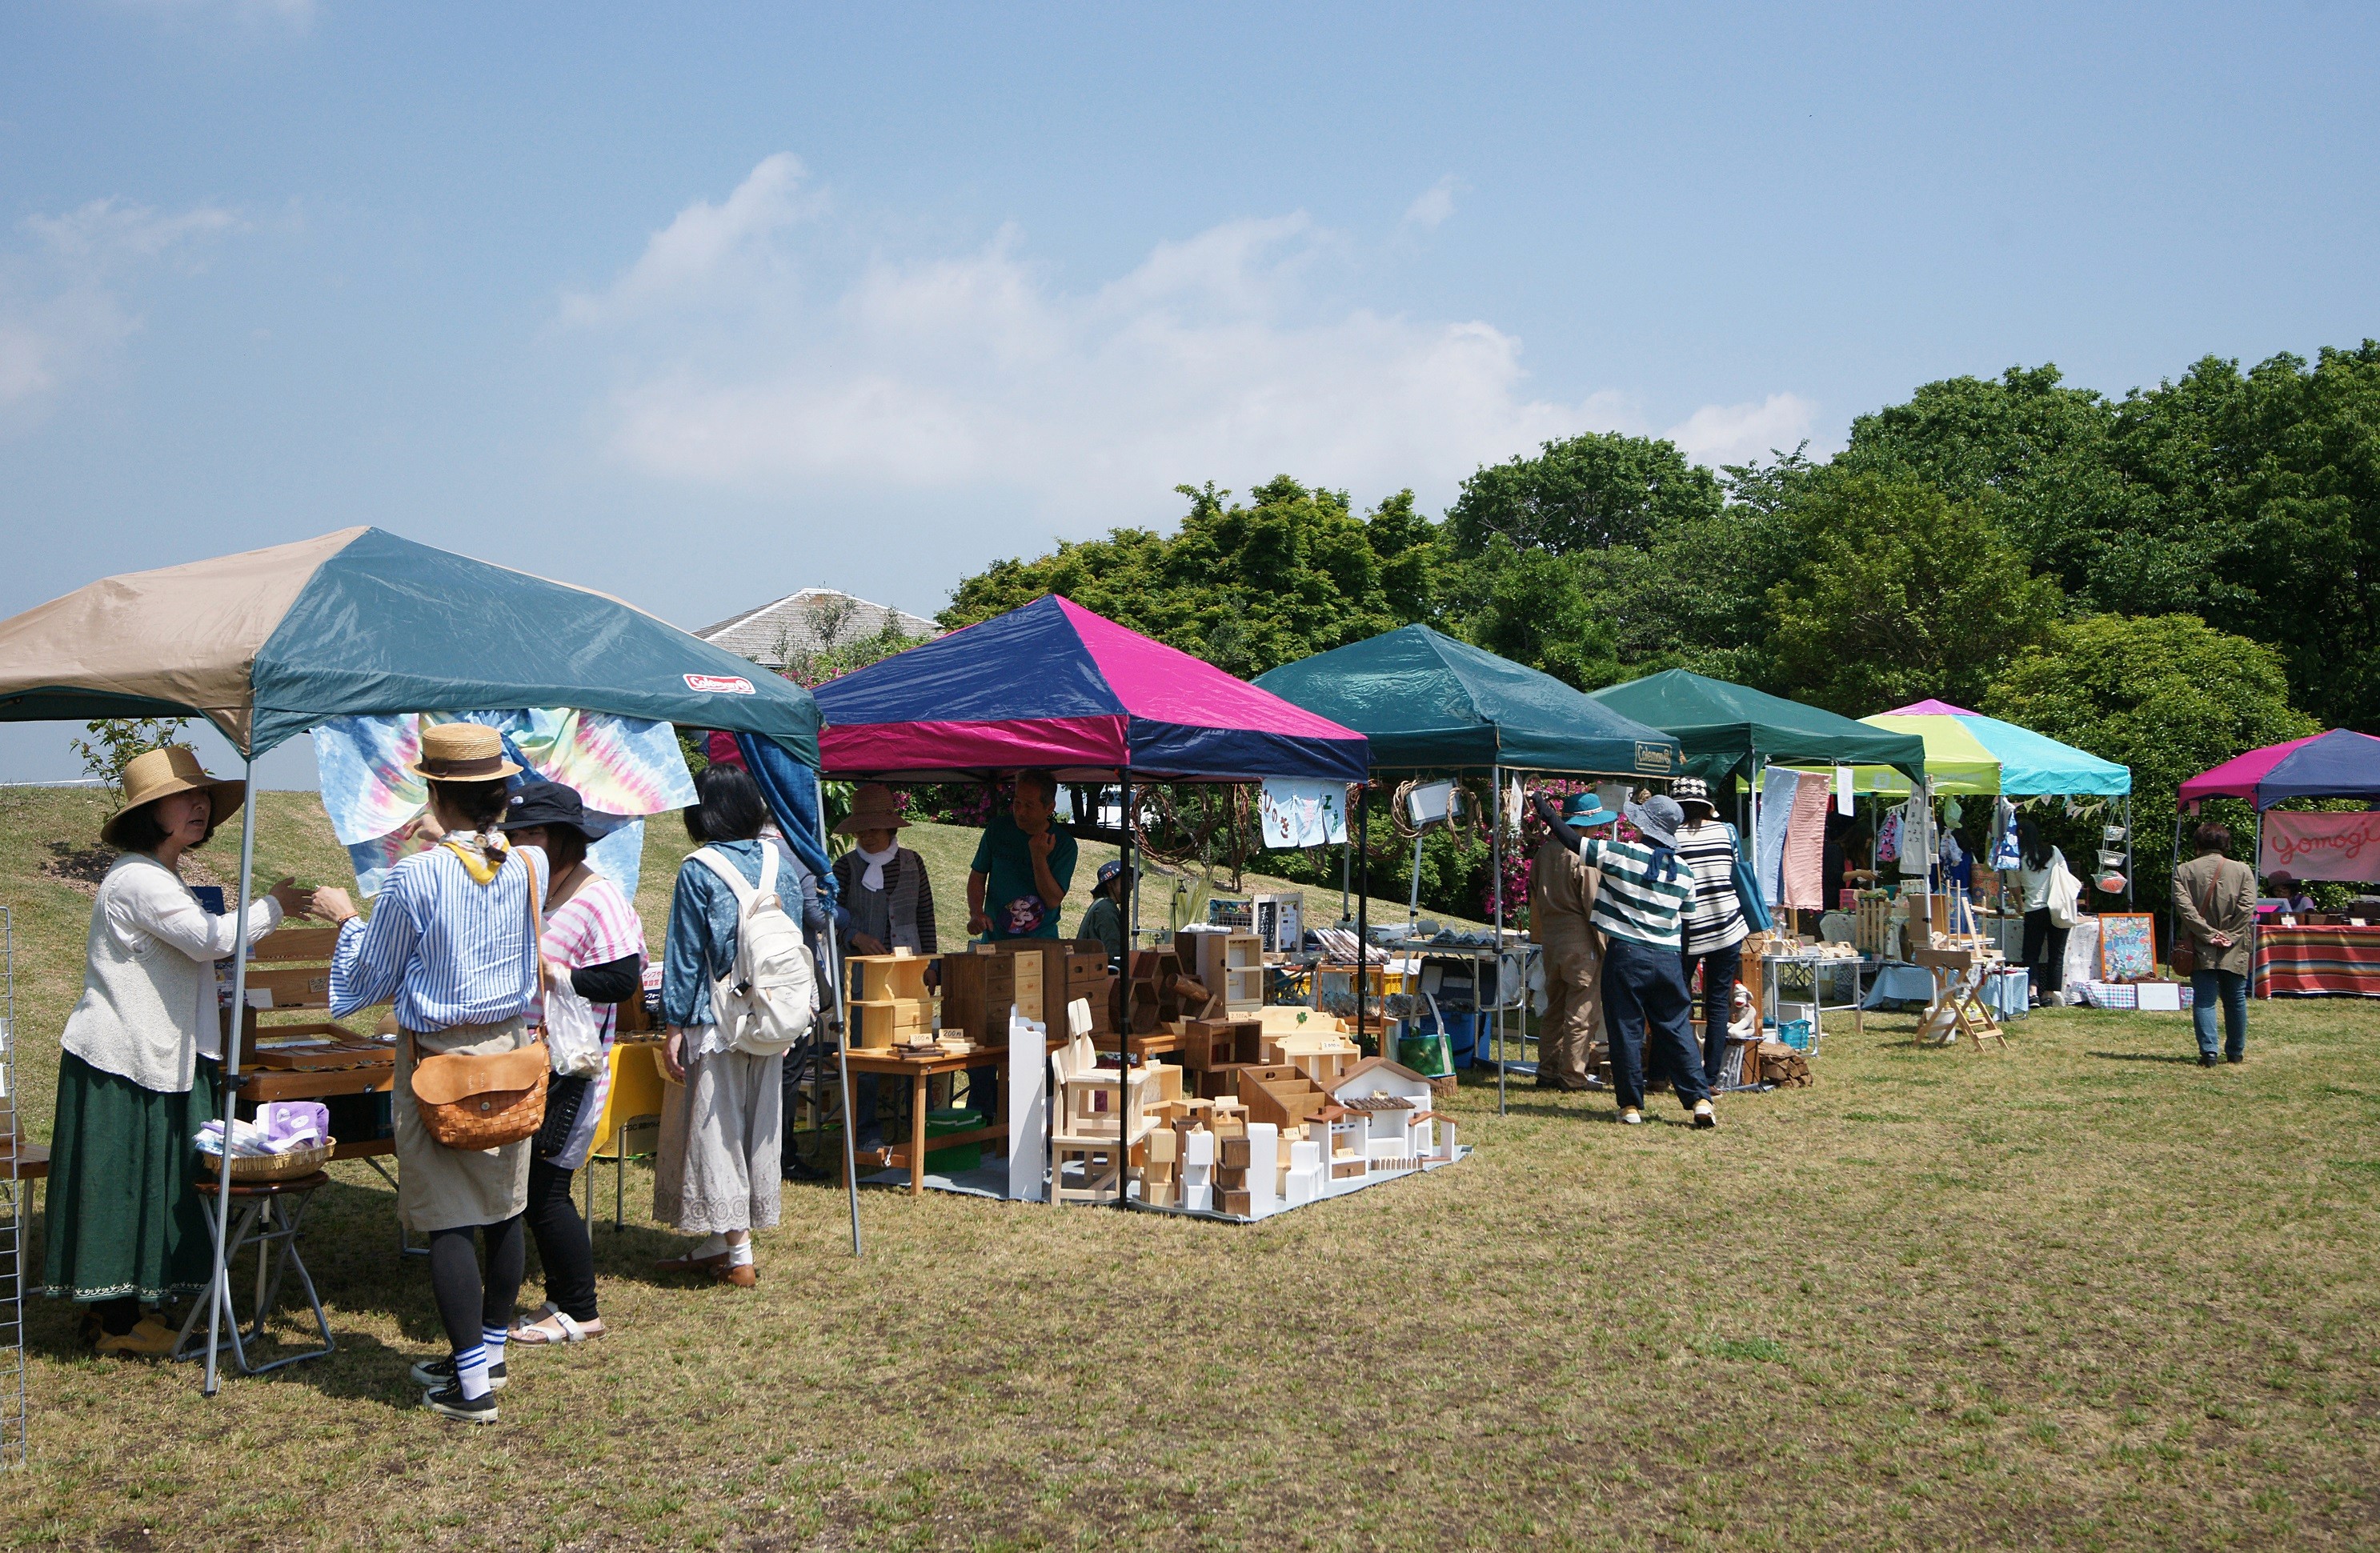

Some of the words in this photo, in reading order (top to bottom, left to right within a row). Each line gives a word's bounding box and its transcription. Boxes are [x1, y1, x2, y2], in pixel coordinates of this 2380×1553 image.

[690, 677, 738, 690] Coleman
[1637, 745, 1665, 763] Coleman
[1264, 789, 1289, 839] ひのき
